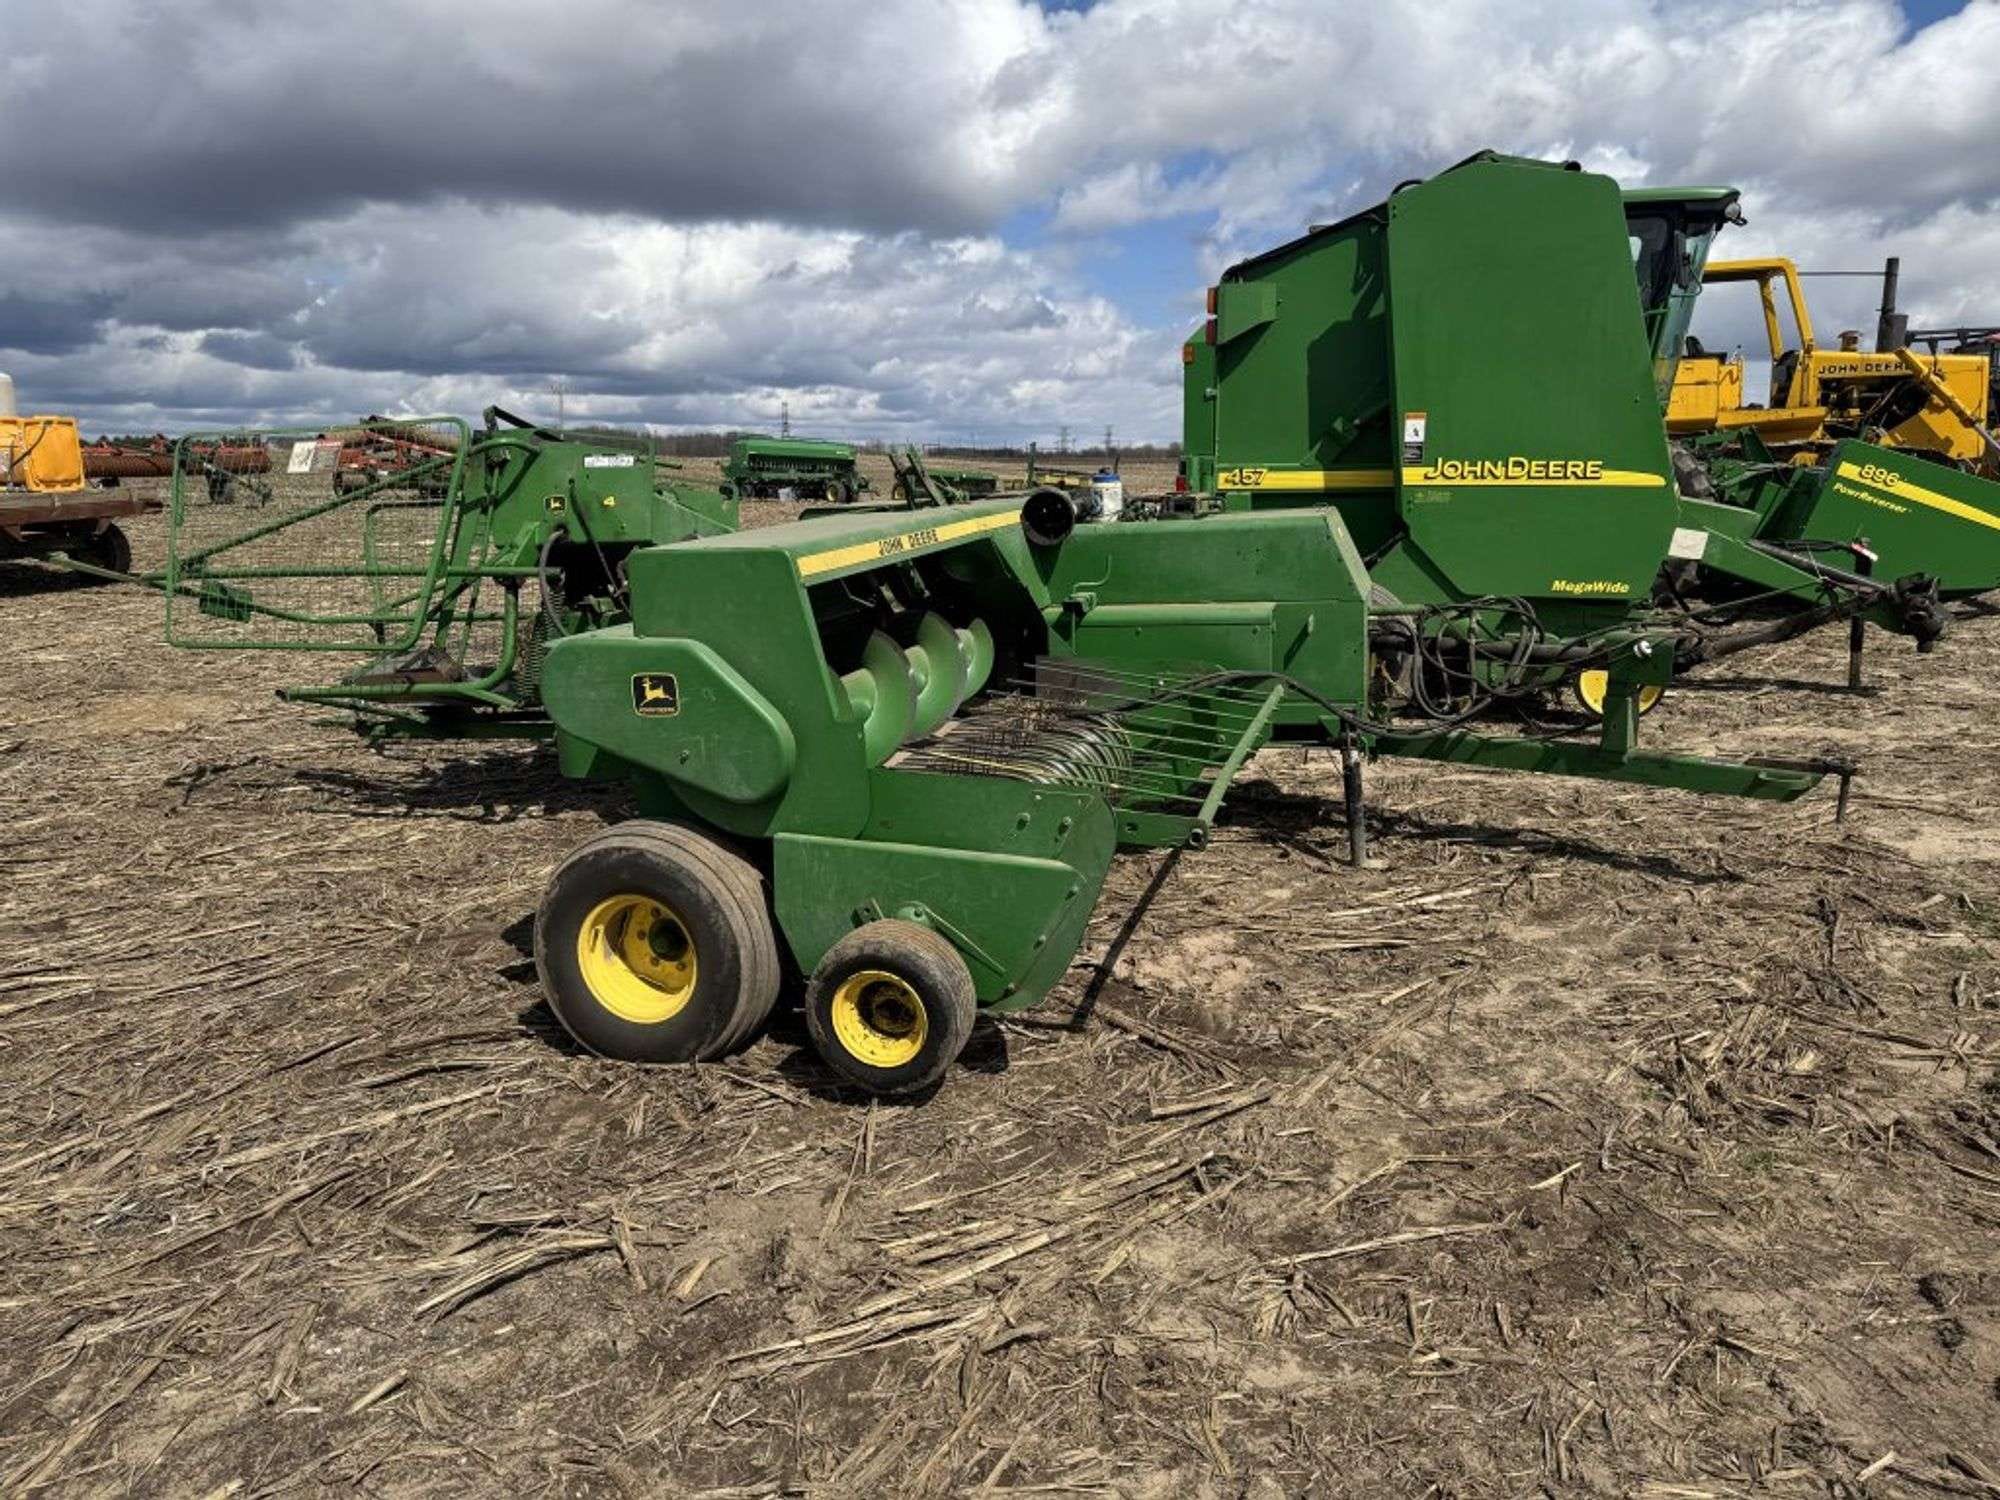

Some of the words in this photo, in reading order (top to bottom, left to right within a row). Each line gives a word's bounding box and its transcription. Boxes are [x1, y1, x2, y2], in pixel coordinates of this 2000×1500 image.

[1818, 363, 1858, 375] JOHN
[1224, 468, 1268, 486] 457
[1423, 456, 1503, 480] JOHN
[1506, 456, 1603, 480] DEERE
[1859, 464, 1900, 488] 896
[878, 535, 904, 557] JOHN
[908, 528, 940, 549] DEERE
[1551, 579, 1630, 596] MegaWide
